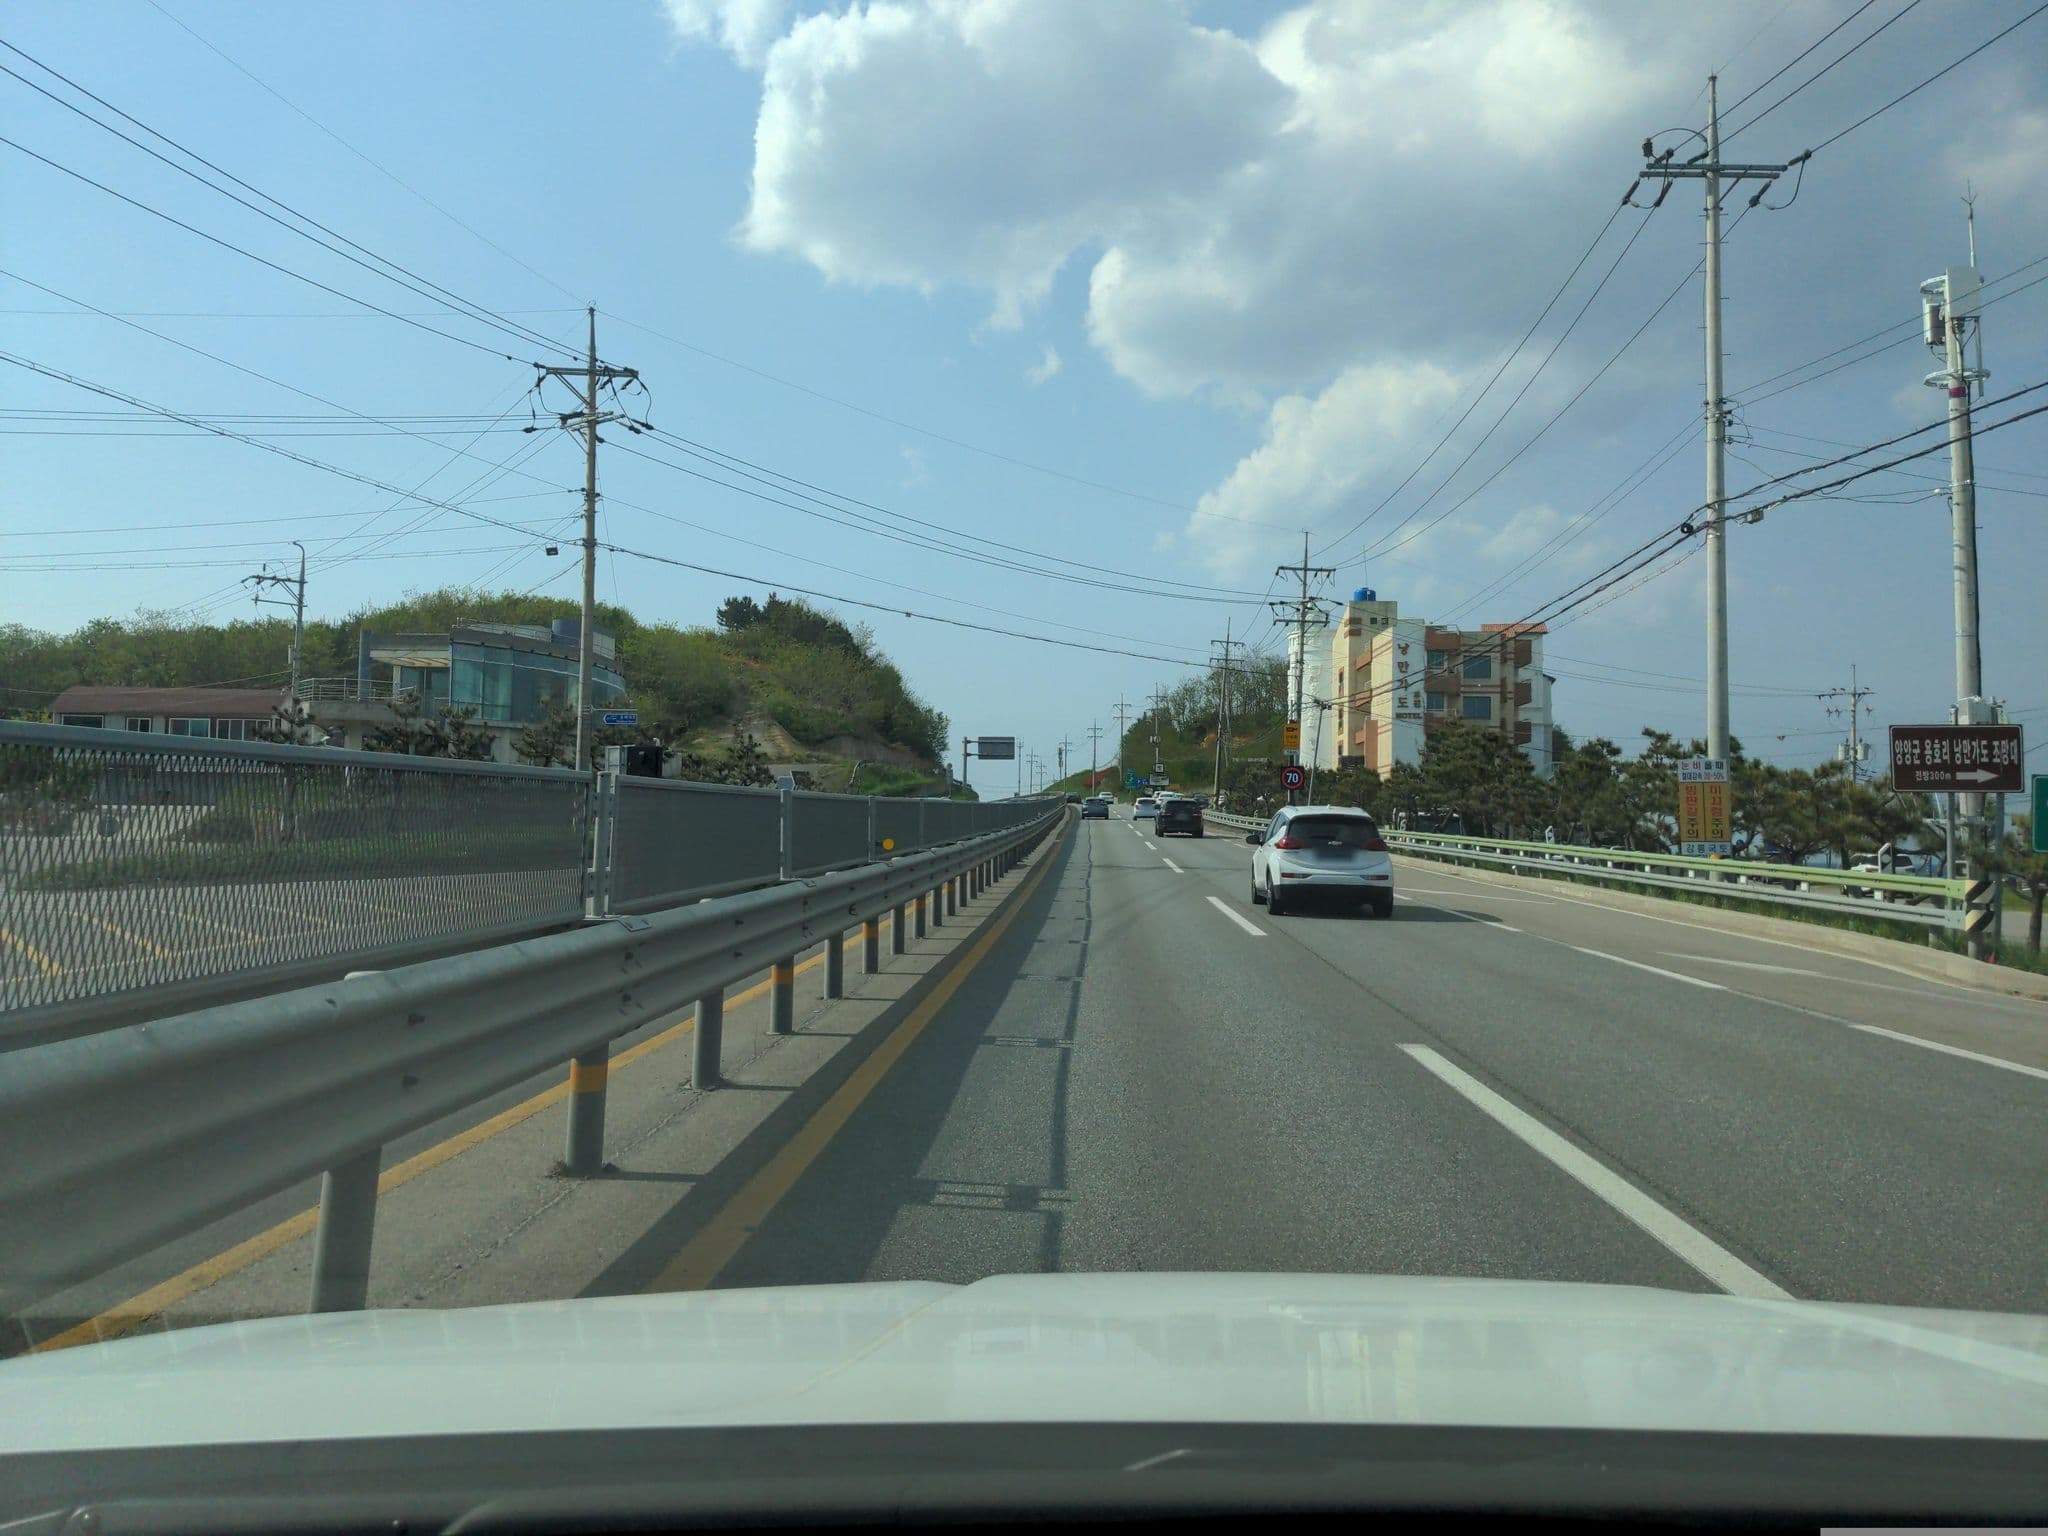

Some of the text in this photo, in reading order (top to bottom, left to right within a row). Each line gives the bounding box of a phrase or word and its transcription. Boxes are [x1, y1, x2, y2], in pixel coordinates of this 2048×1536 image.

[1894, 738, 2018, 765] 양양군 용호리 낭만가도 조망대
[1286, 773, 1299, 784] 70
